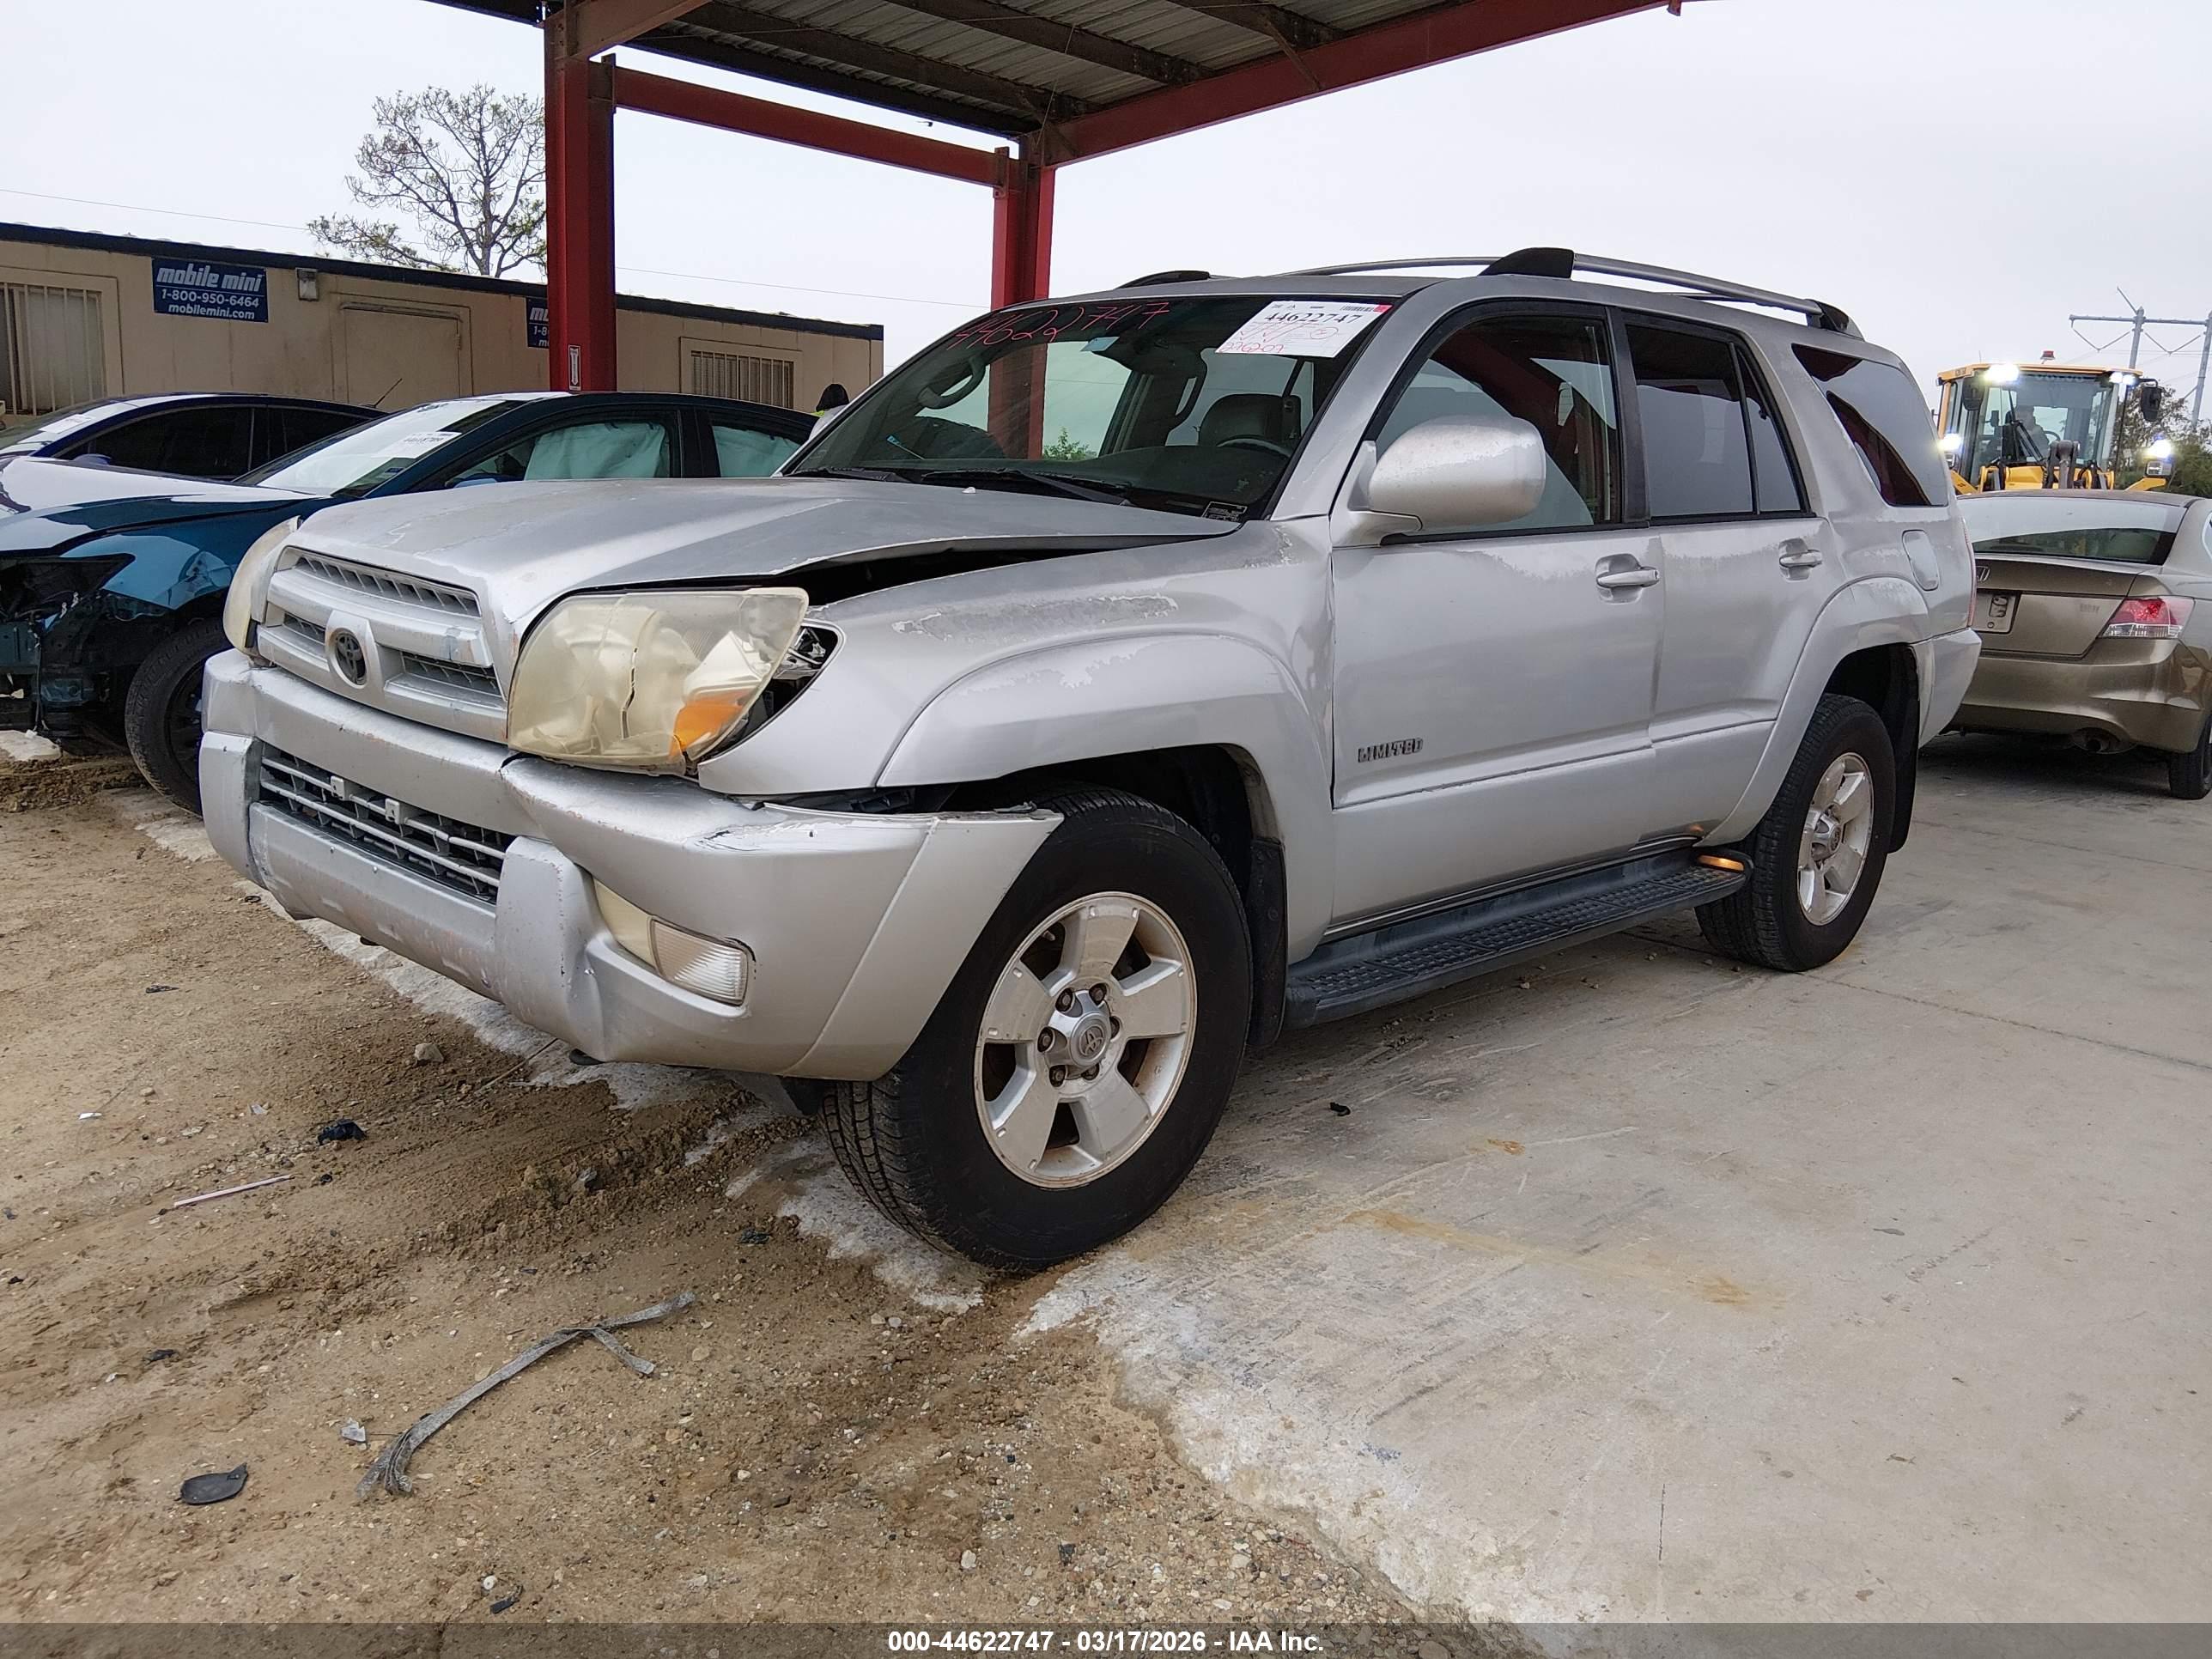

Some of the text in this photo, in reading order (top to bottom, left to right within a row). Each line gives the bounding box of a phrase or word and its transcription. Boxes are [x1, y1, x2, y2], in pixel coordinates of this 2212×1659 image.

[156, 263, 263, 292] mobile mini
[161, 289, 259, 308] 1-800-950-6464
[168, 303, 255, 319] mobilemini.com
[1264, 312, 1364, 324] 44622747
[1358, 738, 1424, 763] LIMITED
